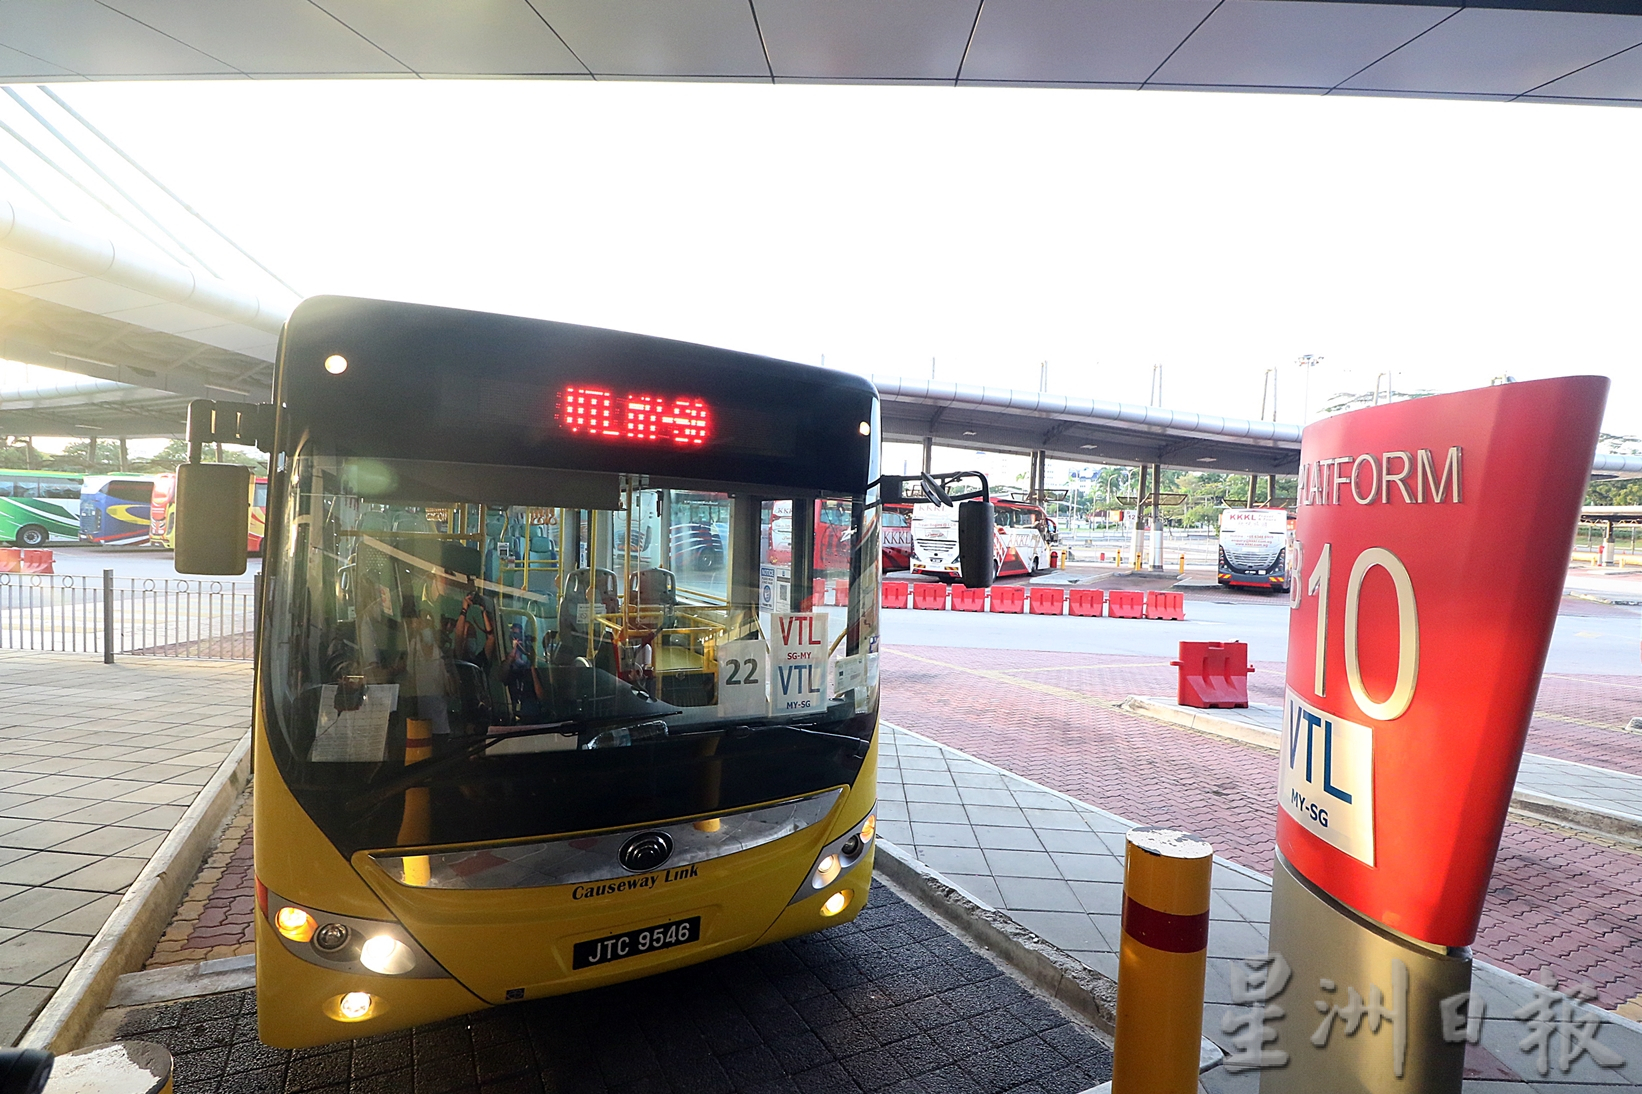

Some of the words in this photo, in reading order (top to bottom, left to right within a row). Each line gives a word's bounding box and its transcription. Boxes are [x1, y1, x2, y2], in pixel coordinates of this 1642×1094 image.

[883, 530, 911, 545] KKKL
[778, 616, 822, 646] VTL
[786, 651, 812, 661] SG-MY
[725, 658, 759, 686] 22
[778, 664, 821, 696] VTL
[786, 700, 811, 709] MY-SG
[1288, 699, 1353, 805] VTL
[1291, 788, 1329, 828] MY-SG
[572, 875, 660, 901] Causeway
[664, 865, 699, 884] Link
[588, 936, 630, 964] JTC
[638, 922, 690, 952] 9546
